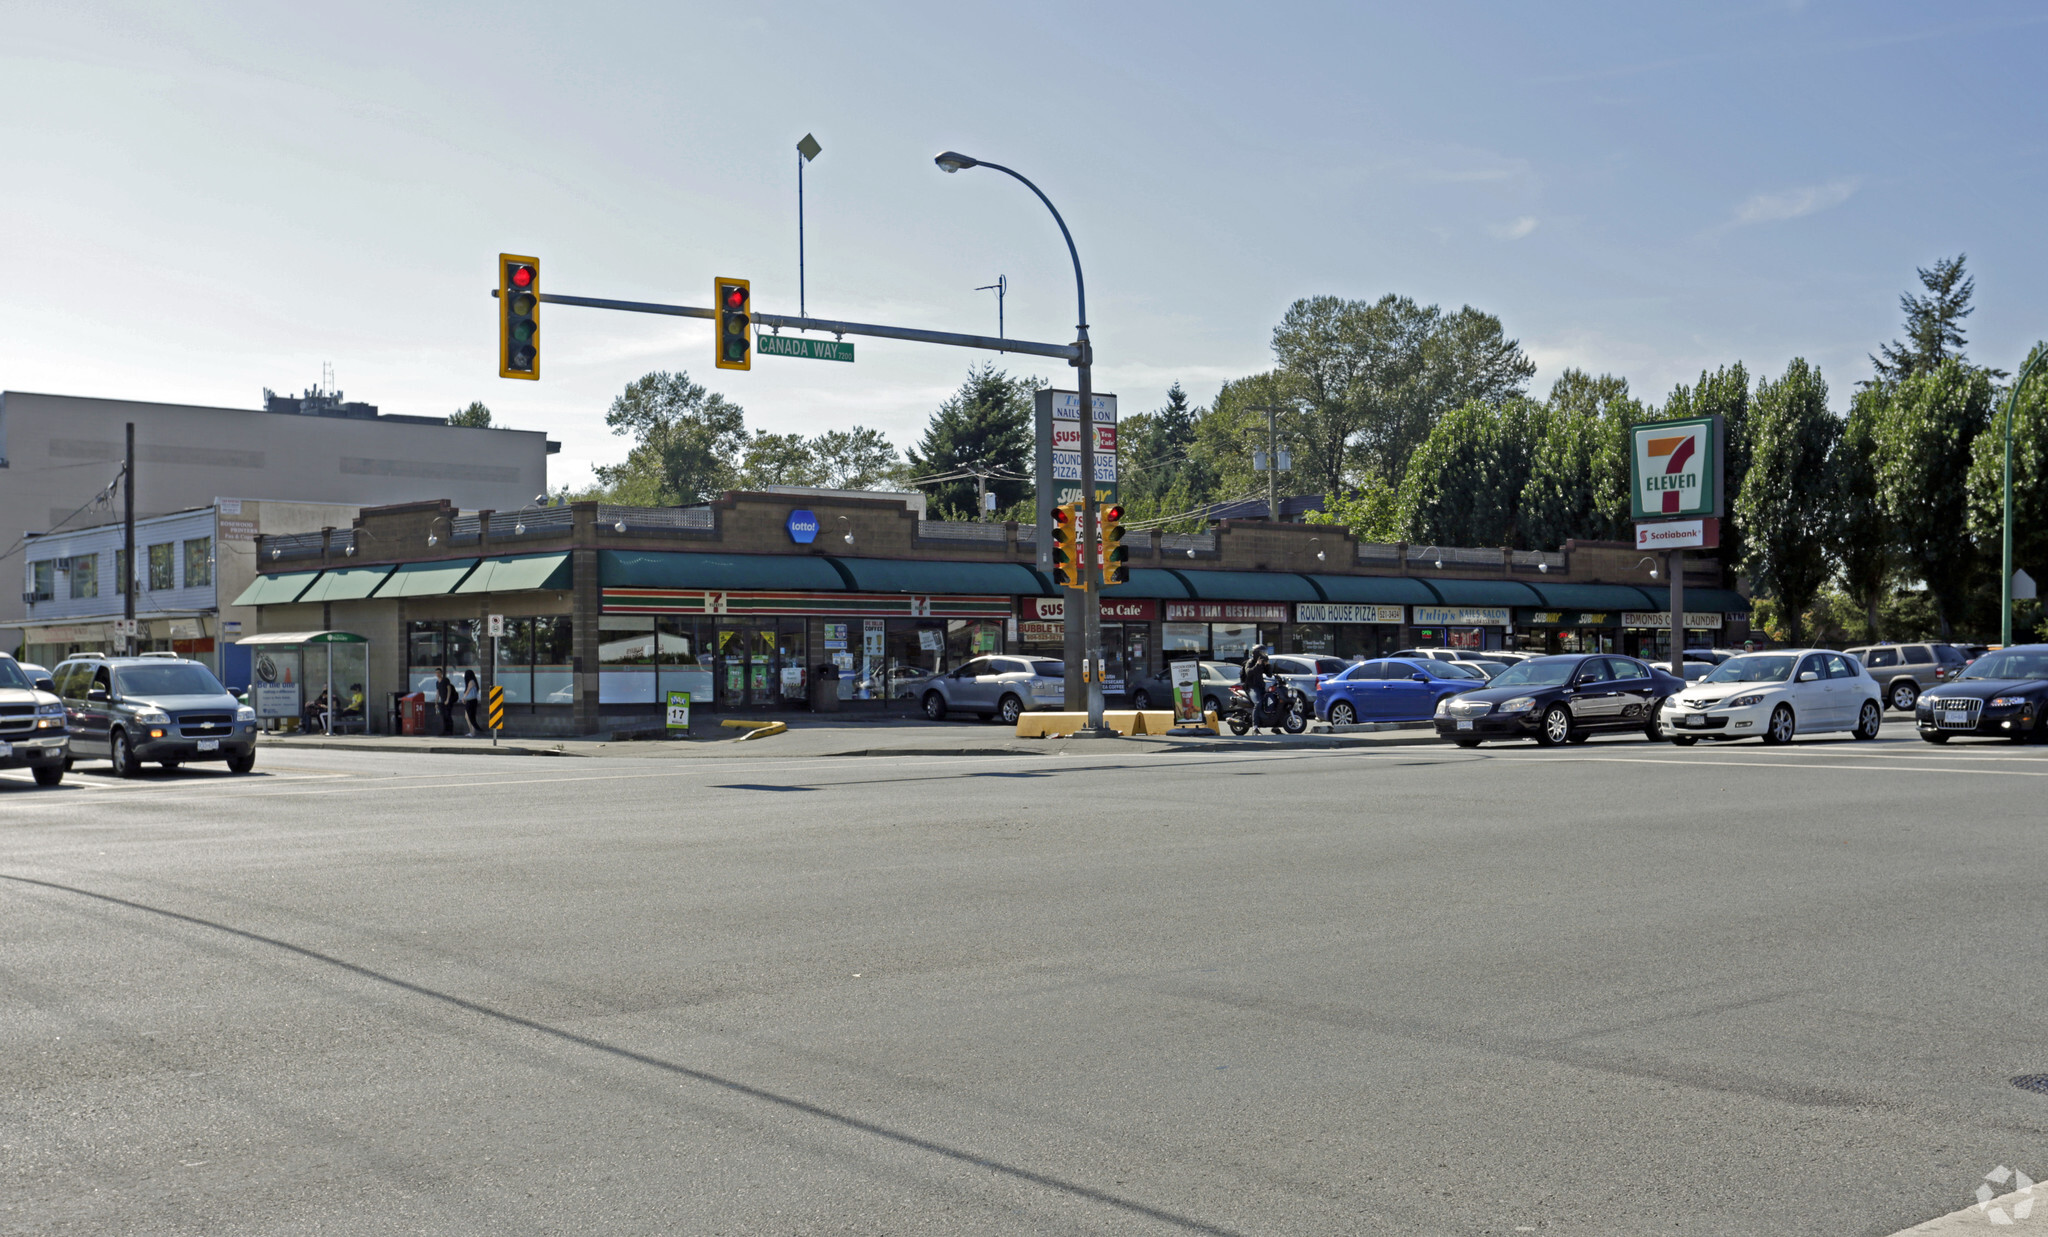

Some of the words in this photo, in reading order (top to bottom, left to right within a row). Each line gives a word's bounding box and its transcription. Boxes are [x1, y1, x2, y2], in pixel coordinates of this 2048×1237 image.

[760, 336, 808, 356] CANADA
[814, 341, 838, 358] WAY
[1094, 411, 1110, 420] LON
[1094, 456, 1113, 468] OUSE
[1053, 466, 1077, 478] PIZZA
[1094, 469, 1115, 480] ASTA
[792, 522, 815, 531] lotto!
[1651, 529, 1697, 541] Scotiabank
[1041, 603, 1063, 616] SUS
[1100, 604, 1114, 615] ea
[1170, 605, 1194, 616] DAYS
[1200, 605, 1220, 617] THAI
[1226, 605, 1284, 617] RESTAURANT
[1301, 606, 1325, 620] ROUND
[1328, 606, 1352, 621] HOUSE
[1355, 607, 1376, 621] PIZZA
[1418, 609, 1455, 624] Tulip's
[1459, 609, 1480, 618] NAILS
[1483, 610, 1506, 618] SALON
[1533, 613, 1562, 623] SUBWAY
[1579, 614, 1607, 624] SUBWAY
[1625, 614, 1662, 625] EDMONDS
[1686, 616, 1720, 626] LAUNDRY
[1019, 624, 1052, 633] BUBBLE
[1054, 624, 1064, 633] TE
